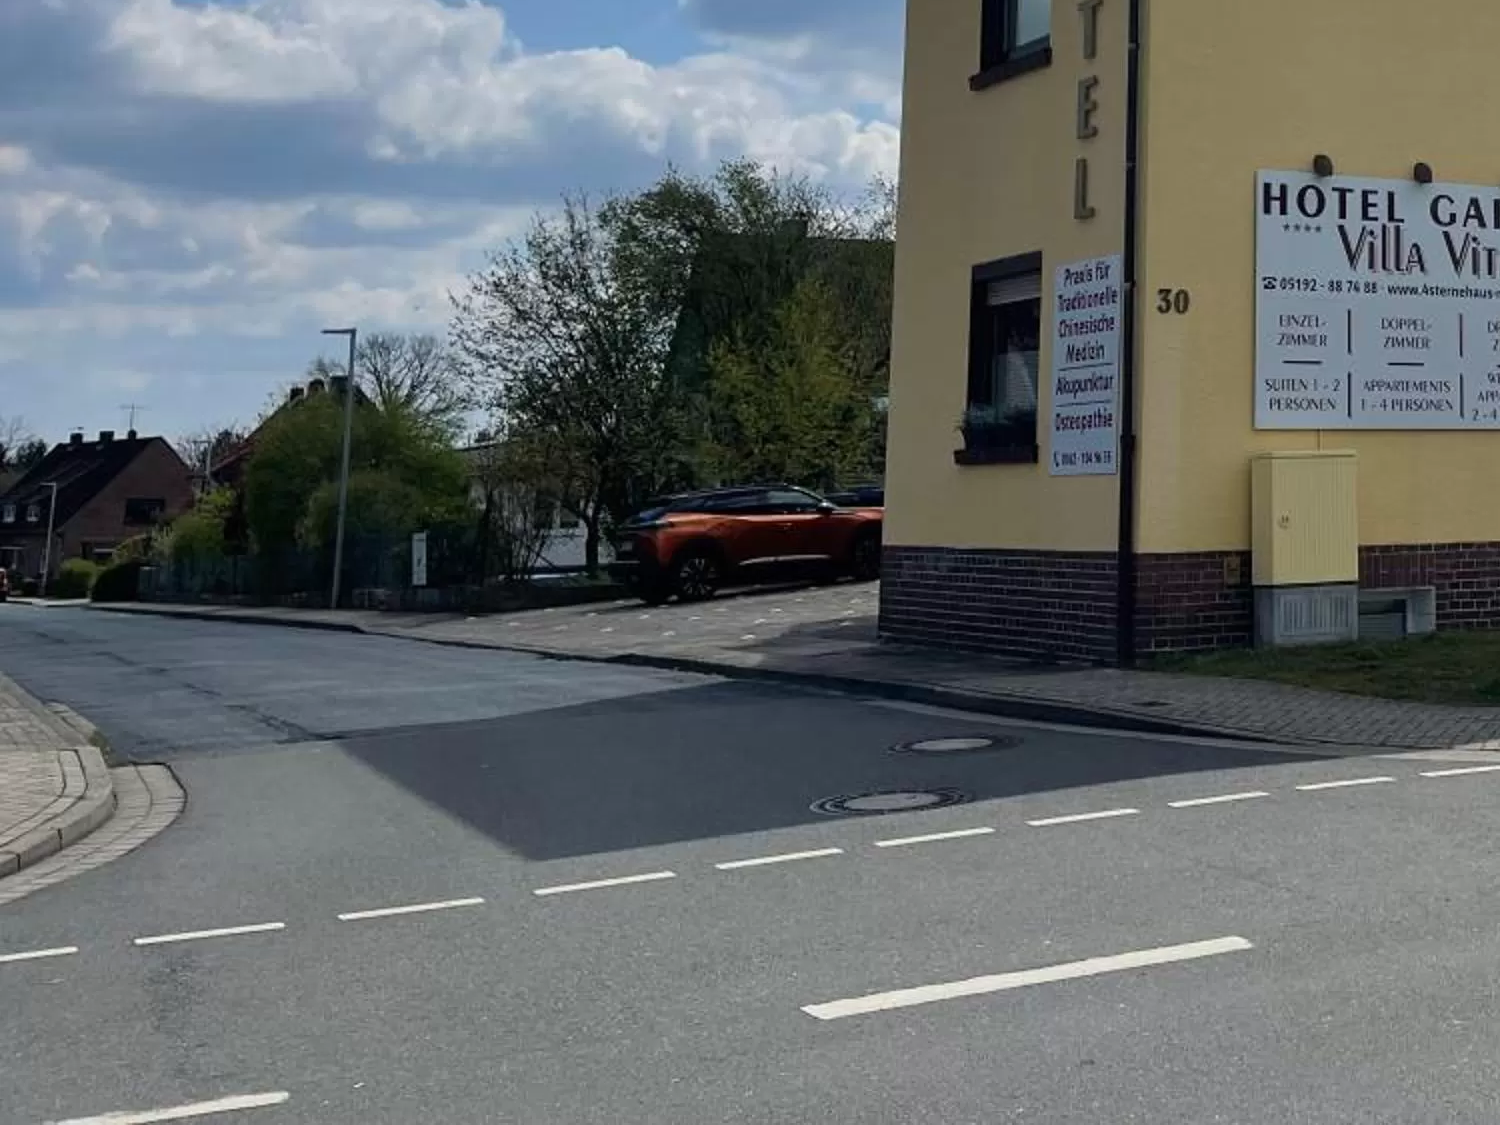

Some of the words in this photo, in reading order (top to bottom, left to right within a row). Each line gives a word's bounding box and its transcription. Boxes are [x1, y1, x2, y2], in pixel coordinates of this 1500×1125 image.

[1263, 181, 1405, 224] HOTEL
[1156, 288, 1190, 314] 30
[1277, 333, 1328, 347] ZIMMER
[1383, 336, 1431, 349] ZIMMER
[1066, 339, 1105, 363] Medizin
[1055, 371, 1113, 399] Akupunktur
[1264, 378, 1308, 392] SUITEN
[1268, 397, 1337, 411] PERSONEN
[1391, 398, 1454, 412] PERSONEN
[1055, 407, 1113, 434] Osteopathie
